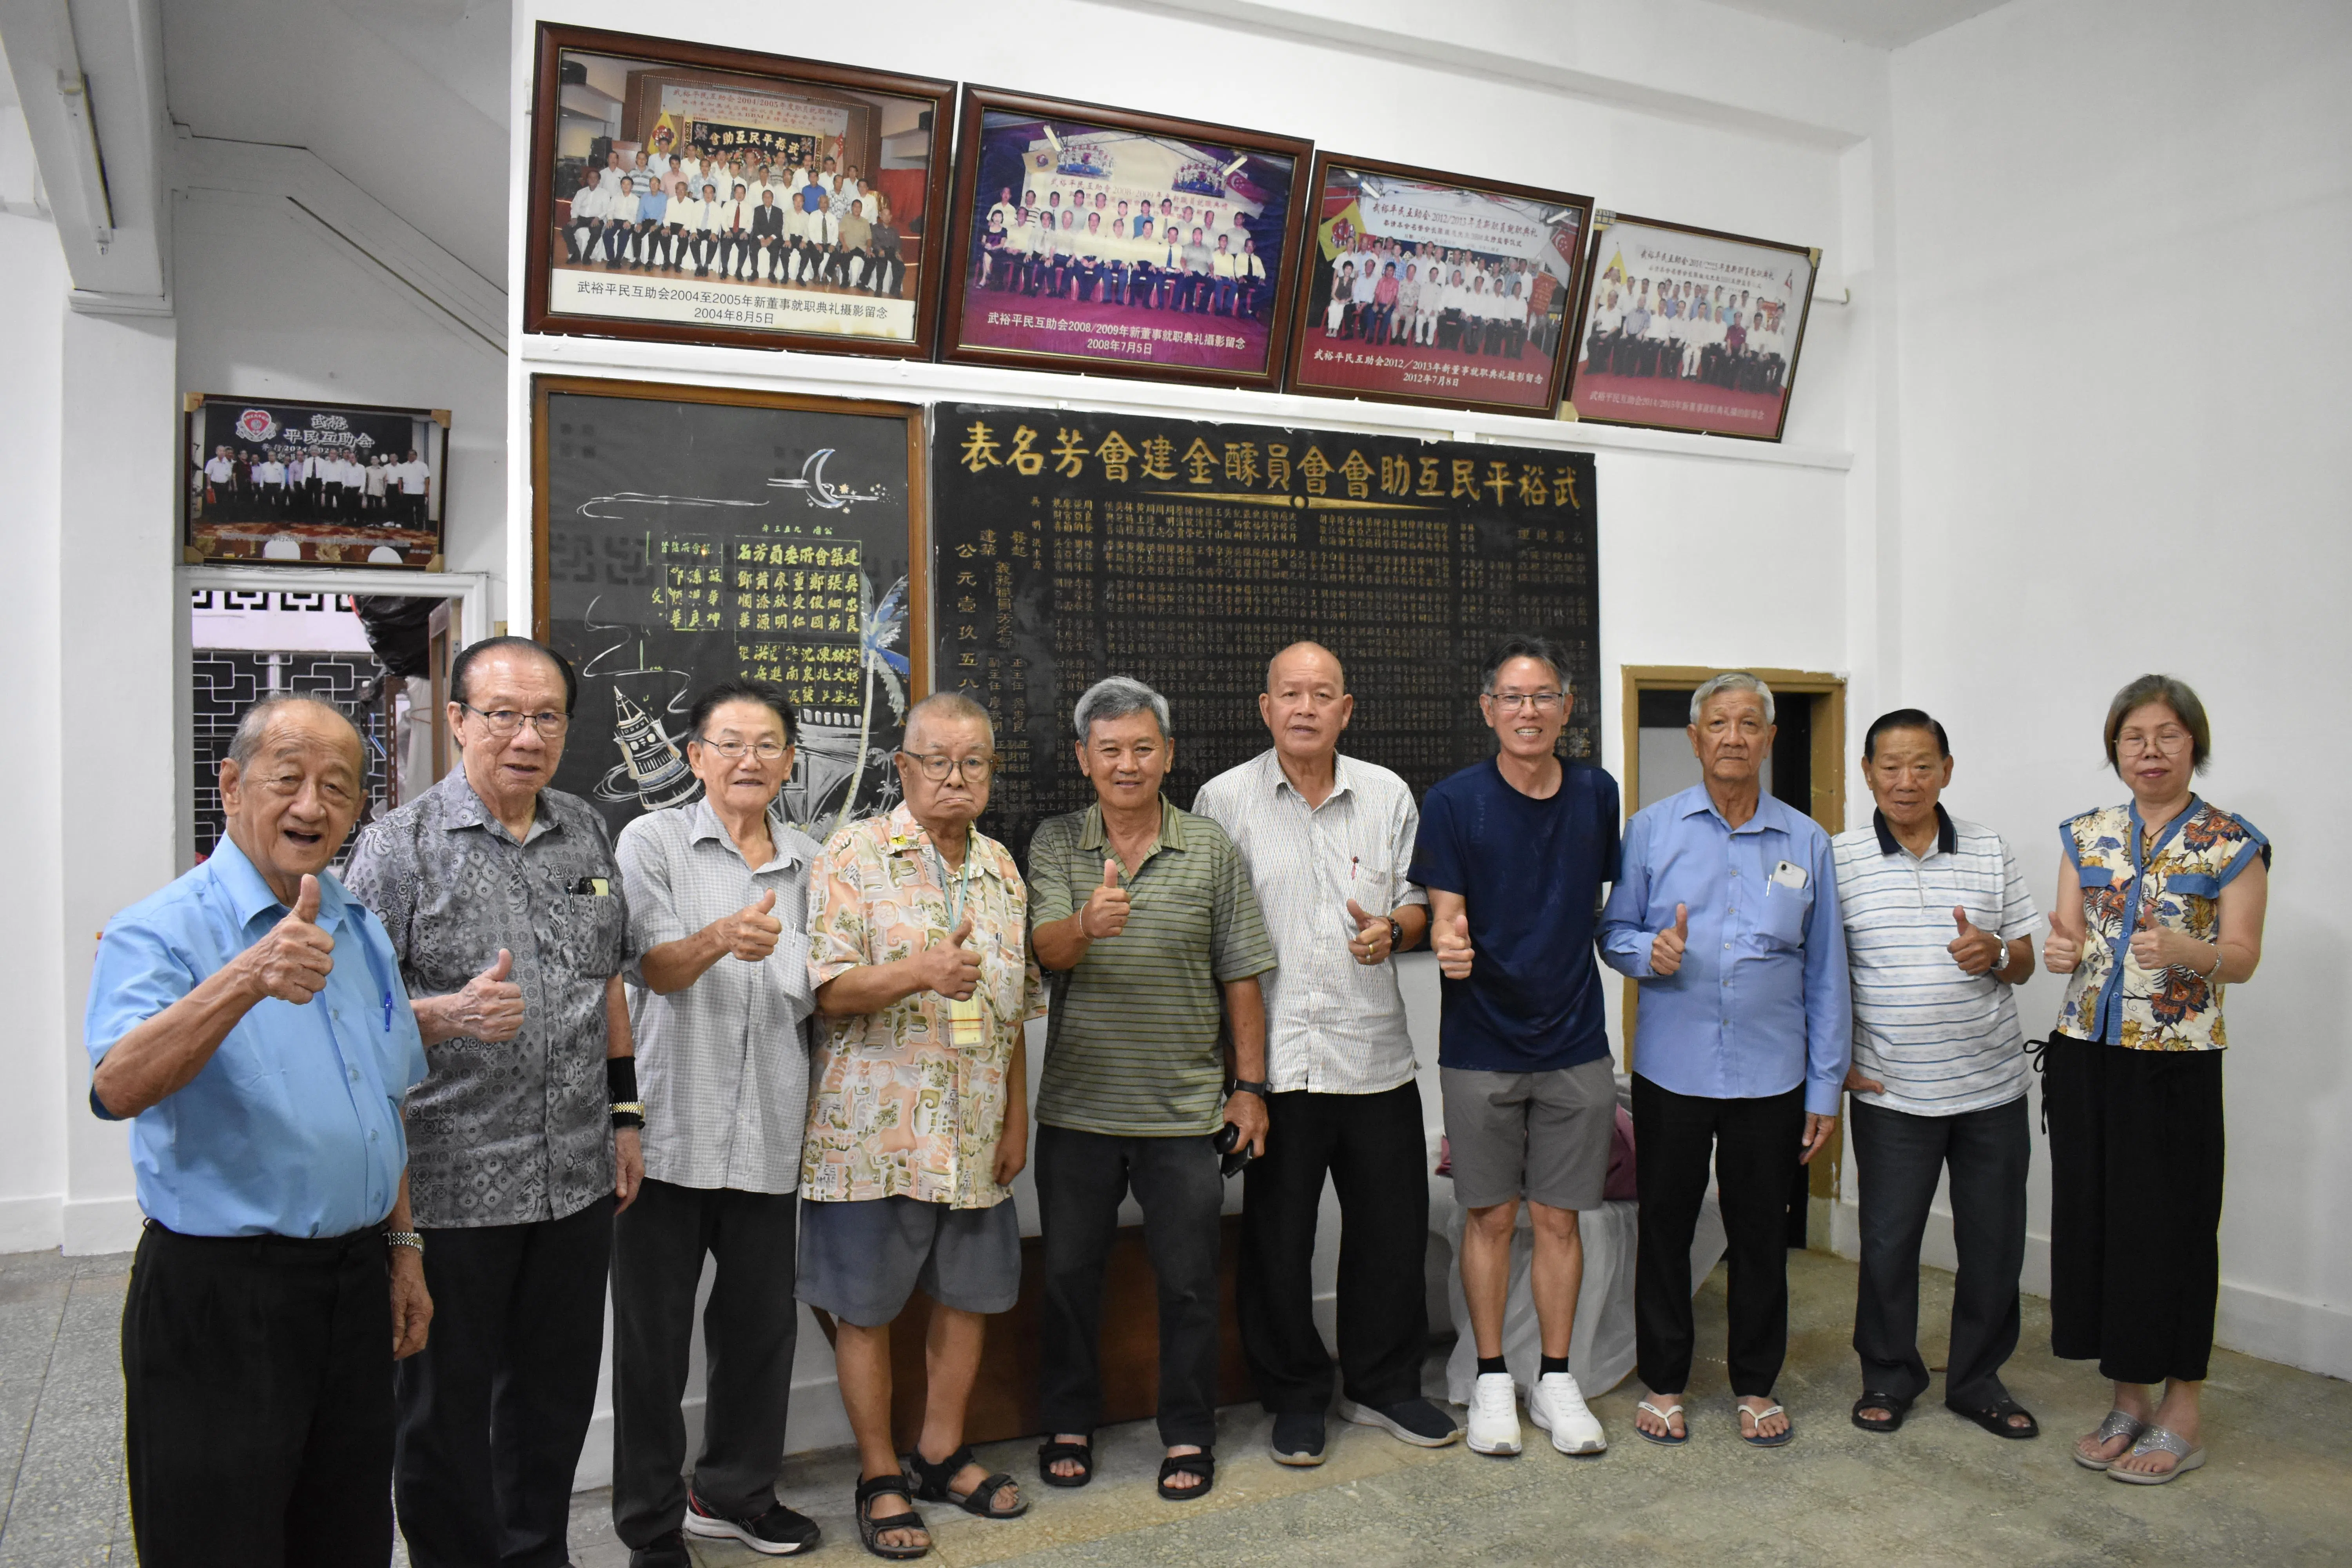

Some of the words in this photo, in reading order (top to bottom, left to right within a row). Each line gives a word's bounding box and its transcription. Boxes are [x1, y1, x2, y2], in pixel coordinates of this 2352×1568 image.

[709, 130, 800, 157] 武裕平民互助會
[577, 280, 888, 319] 武裕平民互助会2004至2005年新董事就职典礼摄影留念
[694, 308, 774, 325] 2004年8月5日
[1087, 338, 1152, 355] 2008年7月5日
[1403, 373, 1459, 387] 2012年7月8日
[311, 414, 348, 430] 武裕
[283, 428, 375, 448] 平民互助会
[737, 543, 860, 567] 建築會所委員芳名
[845, 573, 860, 633] 吳忠良
